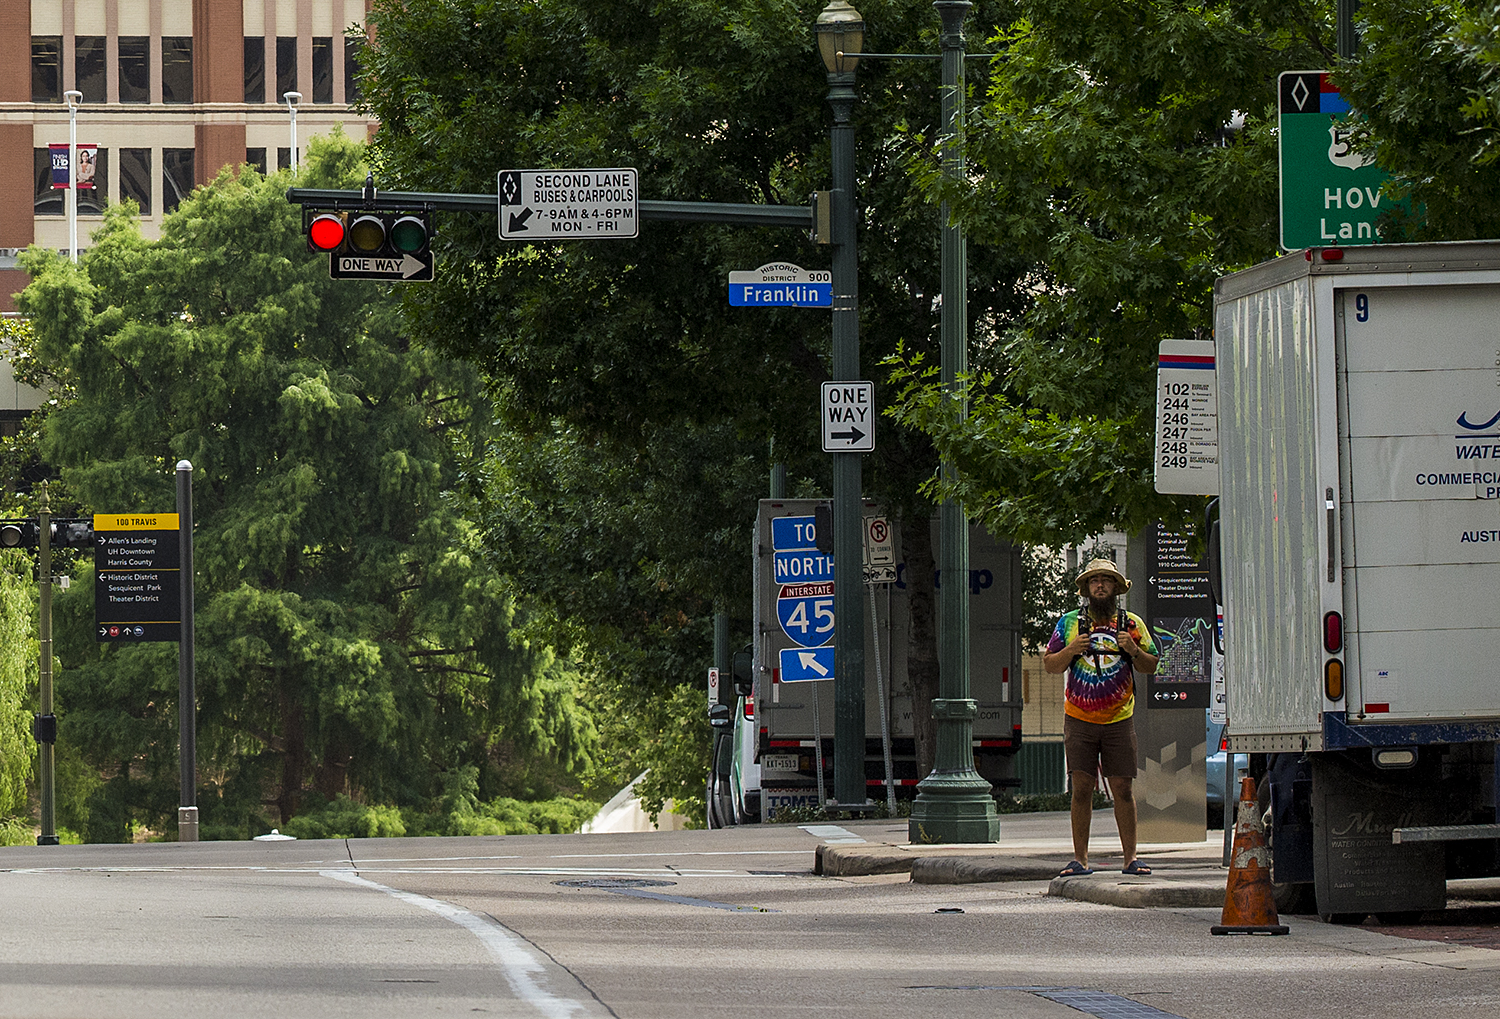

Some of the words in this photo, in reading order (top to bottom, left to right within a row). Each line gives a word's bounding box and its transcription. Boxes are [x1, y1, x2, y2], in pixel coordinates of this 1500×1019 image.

[535, 175, 591, 188] SECOND
[596, 174, 630, 187] LANE
[534, 190, 567, 203] BUSES
[570, 190, 576, 202] &
[578, 189, 633, 202] CARPOOLS
[1324, 187, 1383, 209] HOV
[536, 209, 578, 219] 7-9AM
[581, 210, 589, 218] &
[592, 208, 633, 218] 4-6PM
[551, 222, 582, 232] MON
[597, 221, 618, 231] FRI
[343, 259, 370, 271] ONE
[375, 259, 404, 271] WAY
[760, 265, 799, 274] HISTORIC
[809, 273, 829, 282] 900
[744, 286, 818, 302] Franklin
[1356, 294, 1369, 323] 9
[1164, 383, 1189, 395] 102
[829, 388, 867, 403] ONE
[1163, 398, 1189, 410] 244
[829, 407, 868, 422] WAY
[1163, 413, 1188, 425] 246
[1162, 427, 1188, 439] 247
[1161, 442, 1187, 454] 248
[1161, 456, 1187, 468] 249
[116, 518, 129, 526] 100
[131, 518, 157, 526] TRAVIS
[794, 523, 816, 542] TO
[131, 537, 157, 545] Landing
[128, 559, 153, 567] County
[777, 556, 834, 577] NORTH
[108, 584, 144, 592] Sesquicent
[786, 585, 831, 596] INTERSTATE
[786, 600, 834, 634] 45
